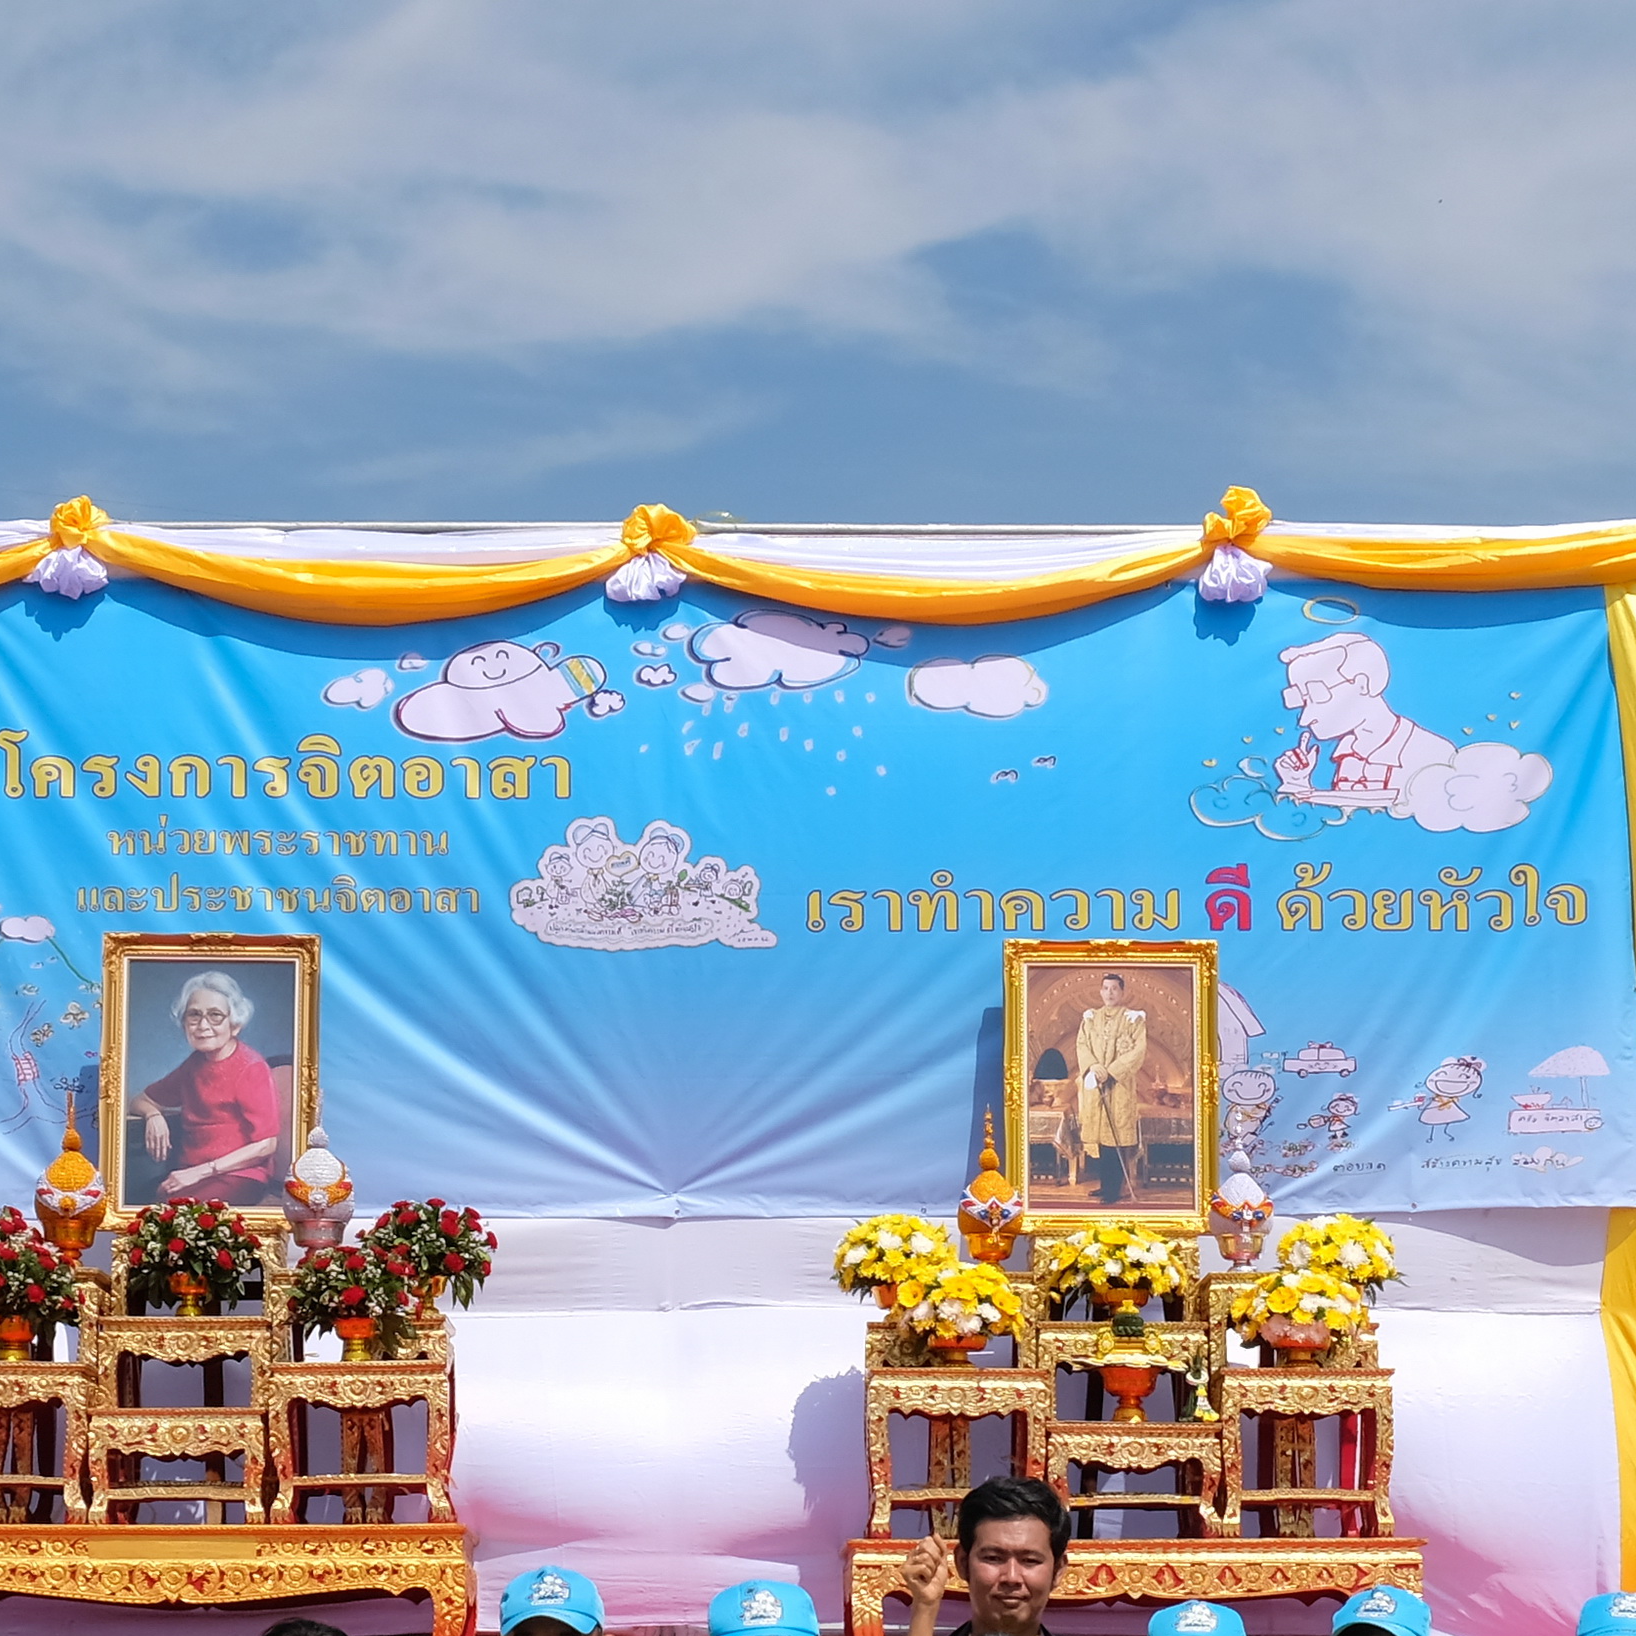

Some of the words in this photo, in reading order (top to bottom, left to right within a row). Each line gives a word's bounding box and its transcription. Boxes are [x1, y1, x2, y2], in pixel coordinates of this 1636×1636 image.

[107, 815, 449, 856] หน่วยพระราชทาน
[76, 873, 480, 913] และประชาชนจิตอาสา
[805, 868, 1181, 931] เราทำความ
[1205, 863, 1252, 931] ดี
[1276, 861, 1589, 931] ด้วยหัวใจ
